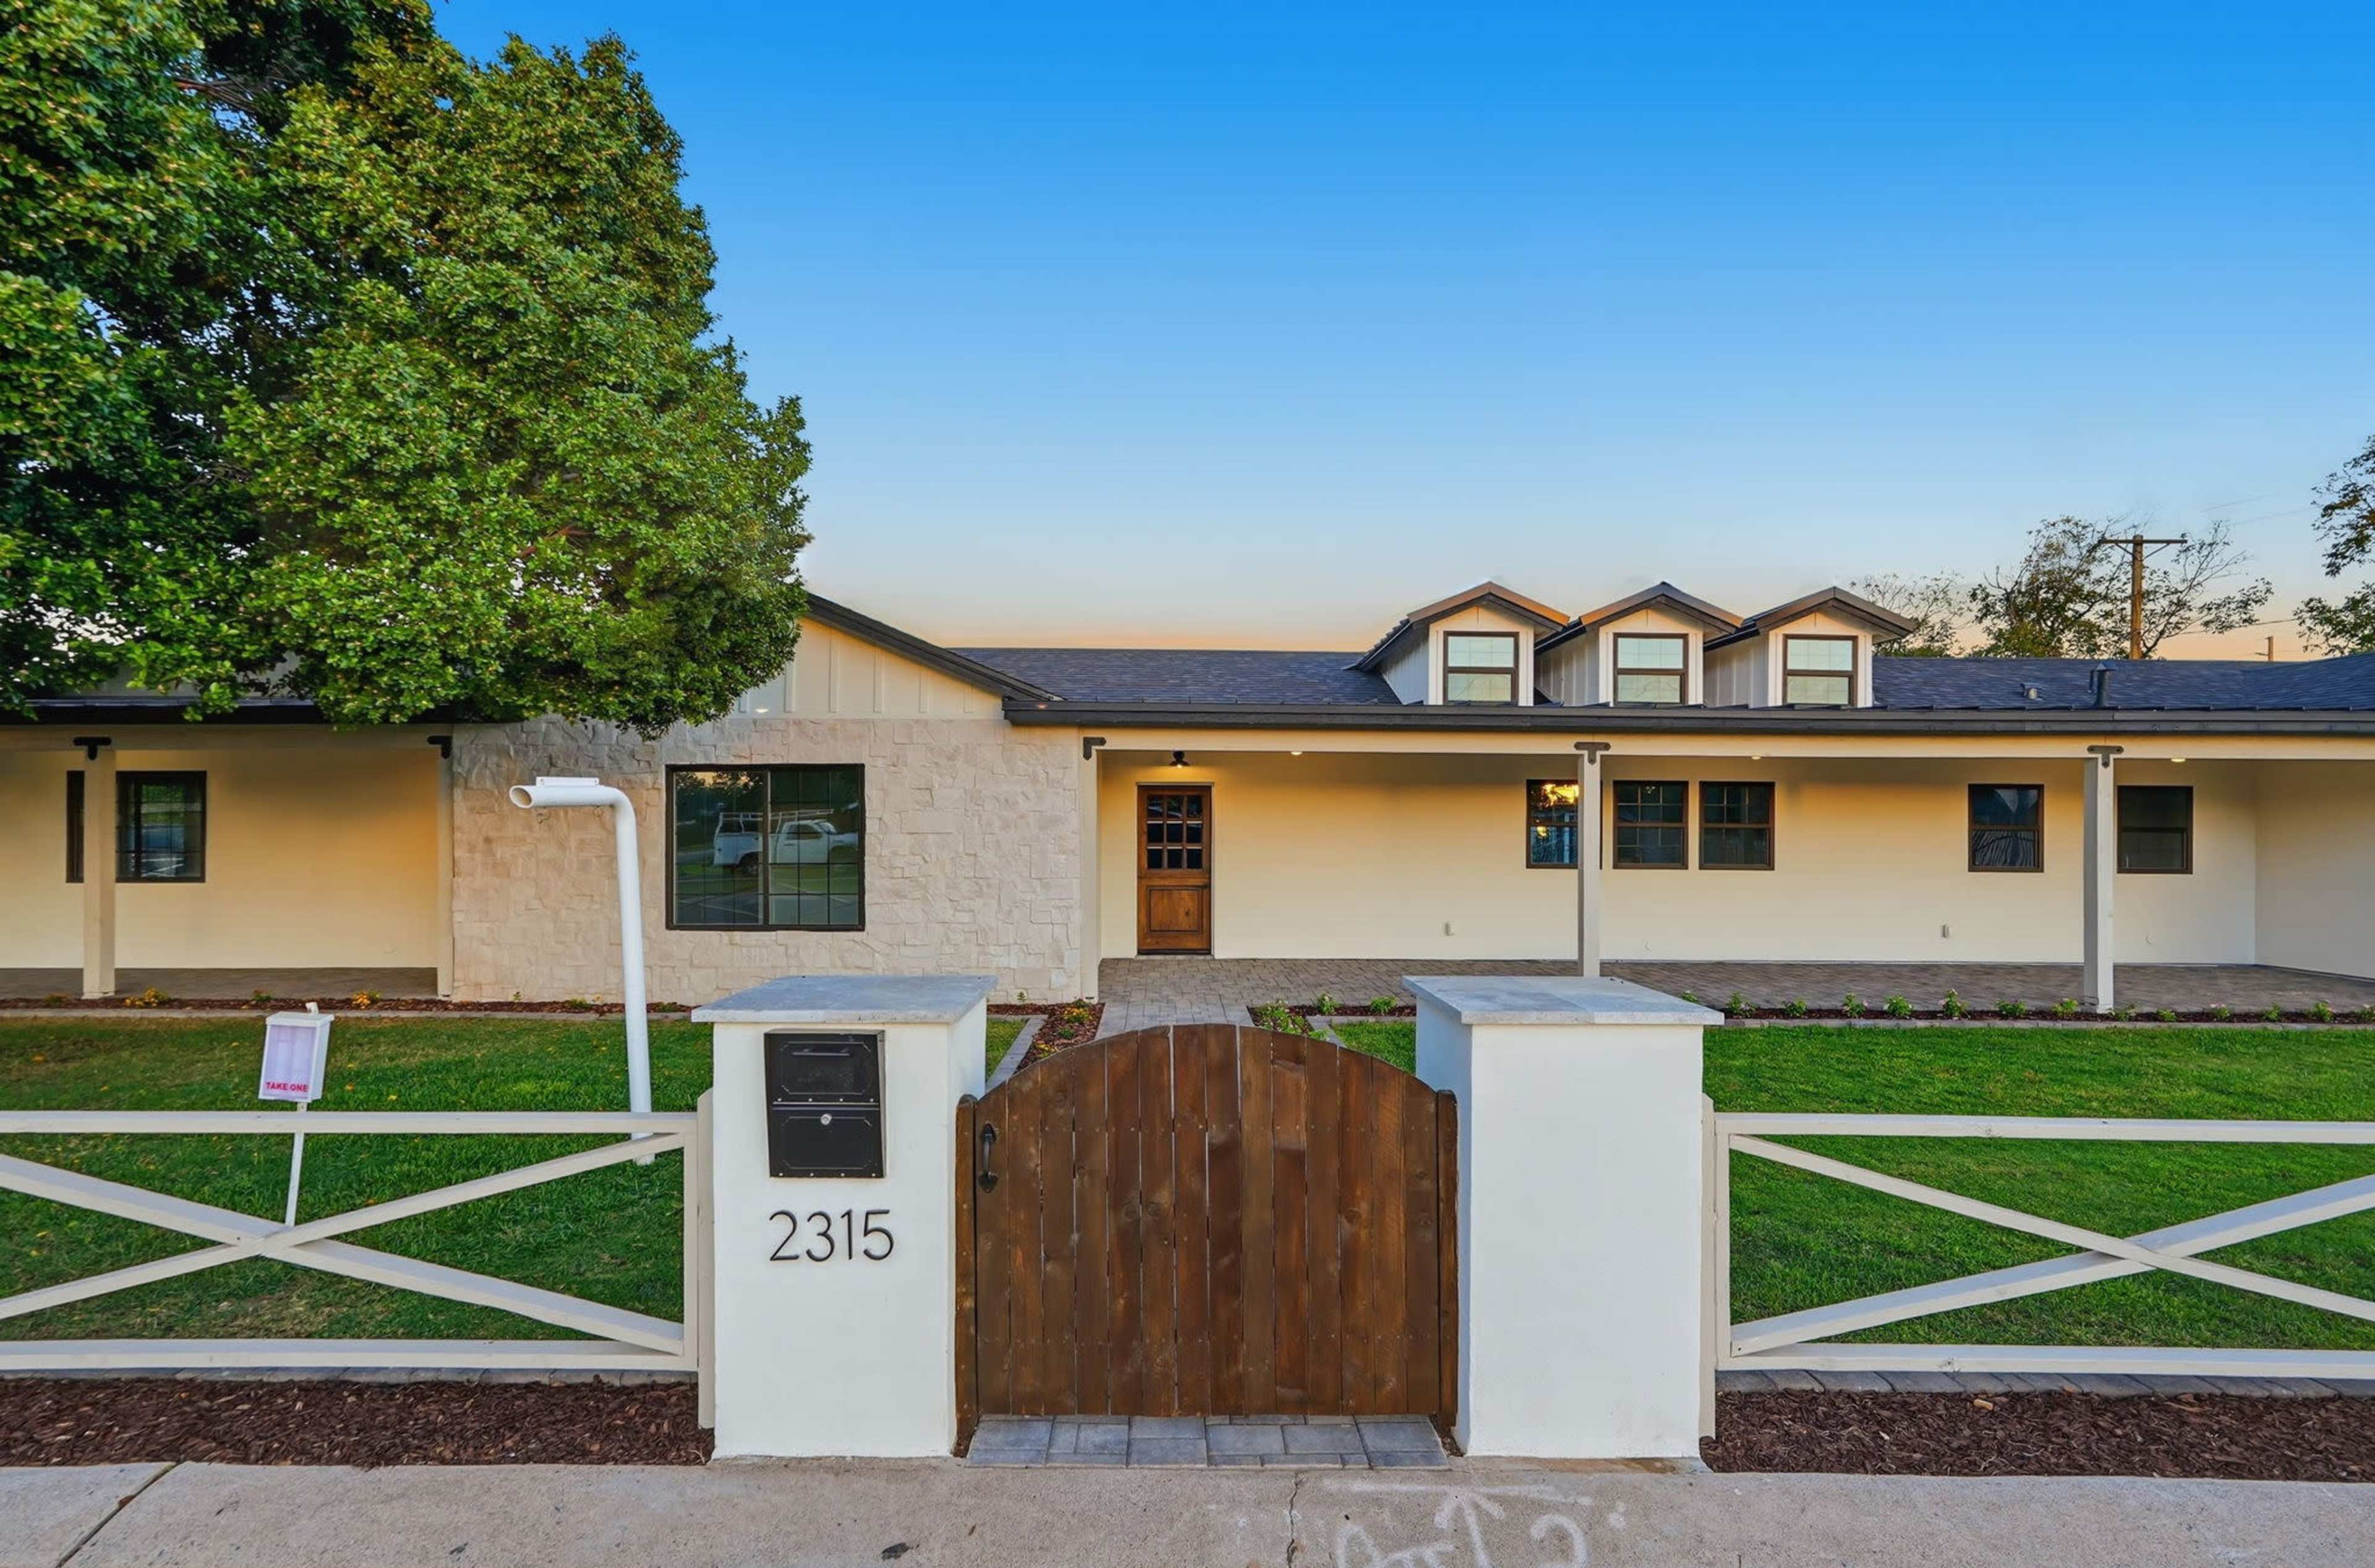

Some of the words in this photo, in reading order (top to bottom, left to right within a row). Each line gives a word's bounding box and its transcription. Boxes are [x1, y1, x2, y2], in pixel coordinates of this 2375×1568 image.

[267, 1082, 288, 1090] TAKE
[290, 1084, 307, 1092] ONE
[769, 1209, 894, 1262] 2315
